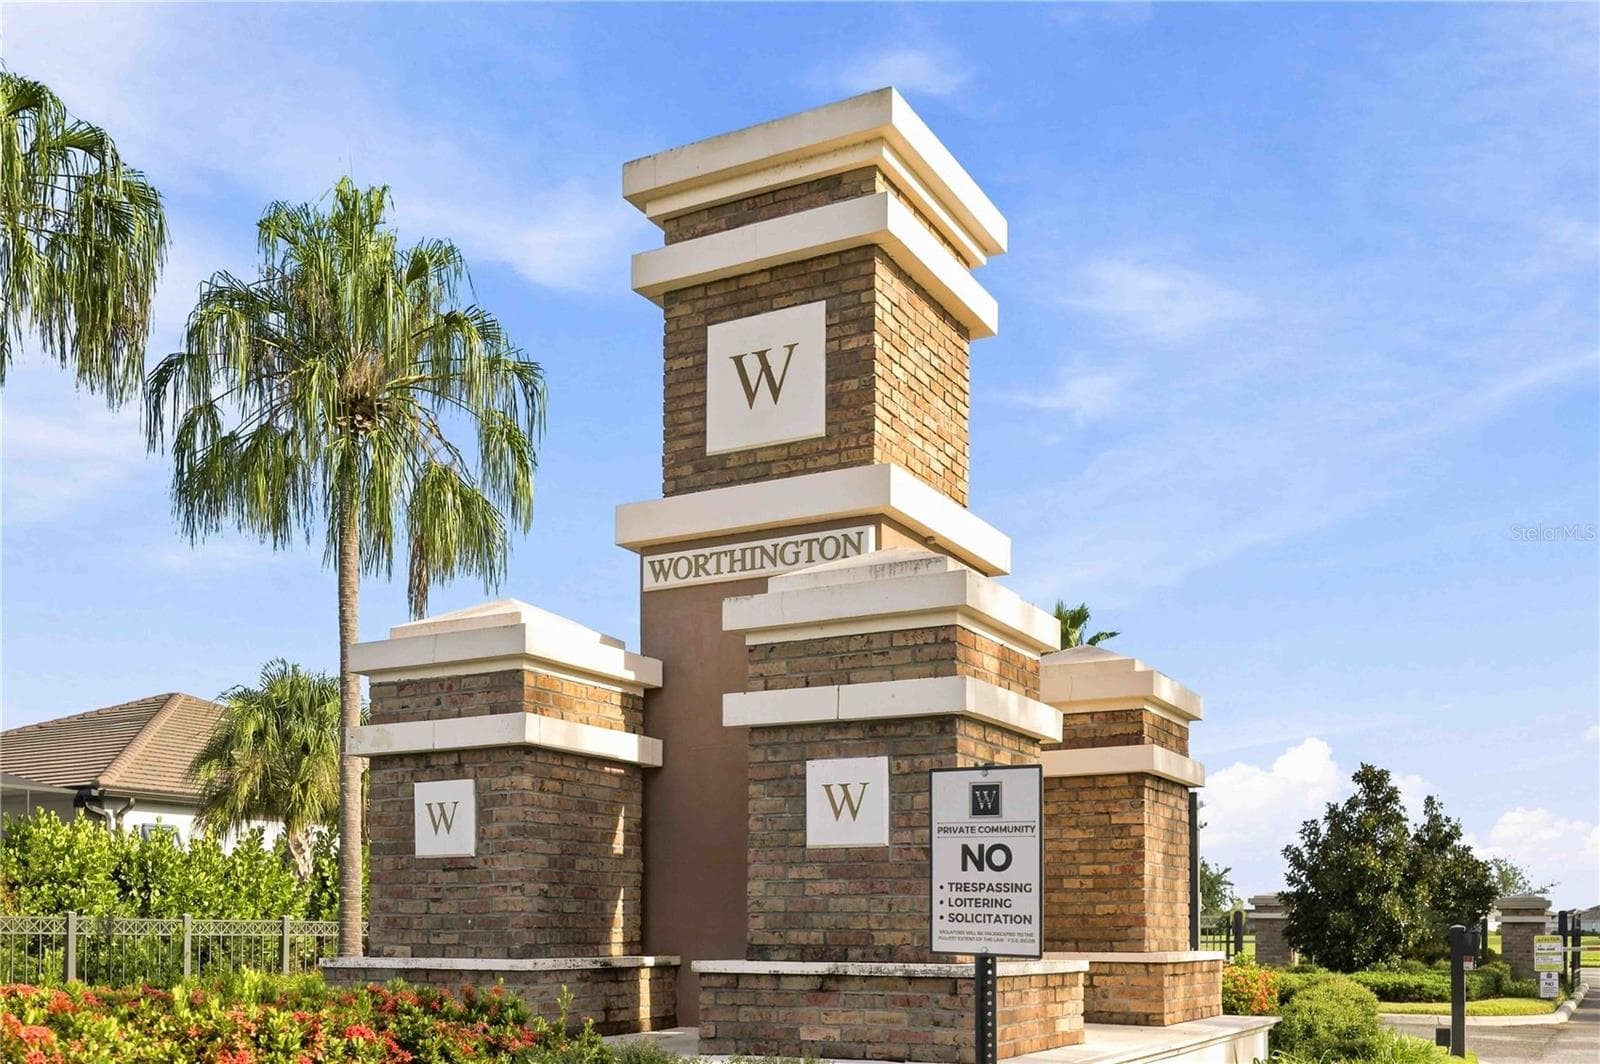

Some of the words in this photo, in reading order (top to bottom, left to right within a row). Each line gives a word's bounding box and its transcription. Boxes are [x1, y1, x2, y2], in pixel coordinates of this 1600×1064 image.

[729, 342, 799, 411] W
[647, 531, 864, 583] WORTHINGTON
[821, 782, 870, 822] W
[975, 790, 997, 810] W
[424, 801, 460, 836] W
[937, 825, 976, 835] PRIVATE
[977, 824, 1036, 834] COMMUNITY
[961, 843, 1013, 872] NO
[947, 882, 1032, 893] TRESPASSING
[947, 897, 1012, 908] LOITERING
[947, 912, 1032, 925] SOLICITATION
